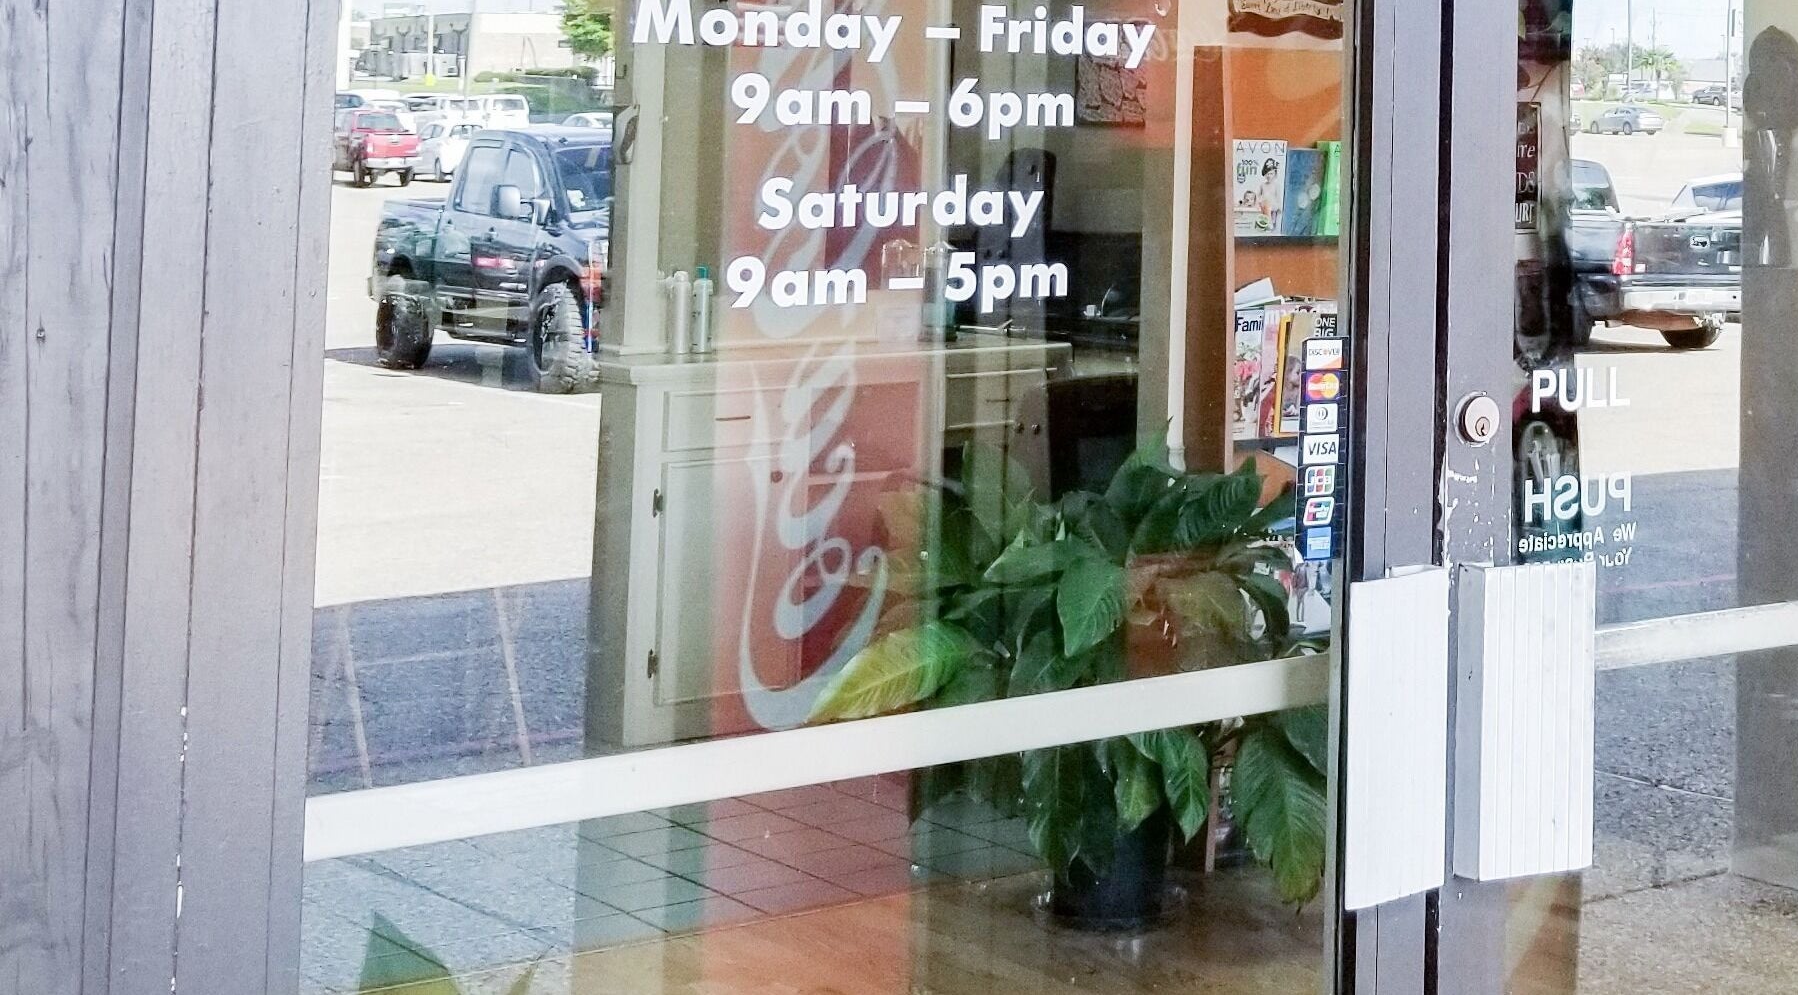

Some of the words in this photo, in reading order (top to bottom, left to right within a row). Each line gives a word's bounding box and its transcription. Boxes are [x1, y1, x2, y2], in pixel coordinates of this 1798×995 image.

[731, 73, 872, 125] 9am
[948, 77, 1075, 140] 6pm
[1236, 142, 1286, 156] AVON
[758, 174, 1044, 237] Saturday
[726, 257, 866, 308] 9am
[944, 252, 1068, 312] 5pm
[1237, 312, 1264, 332] Fami
[1315, 317, 1336, 328] ONE
[1532, 367, 1630, 413] PULL
[1308, 441, 1337, 456] VISA
